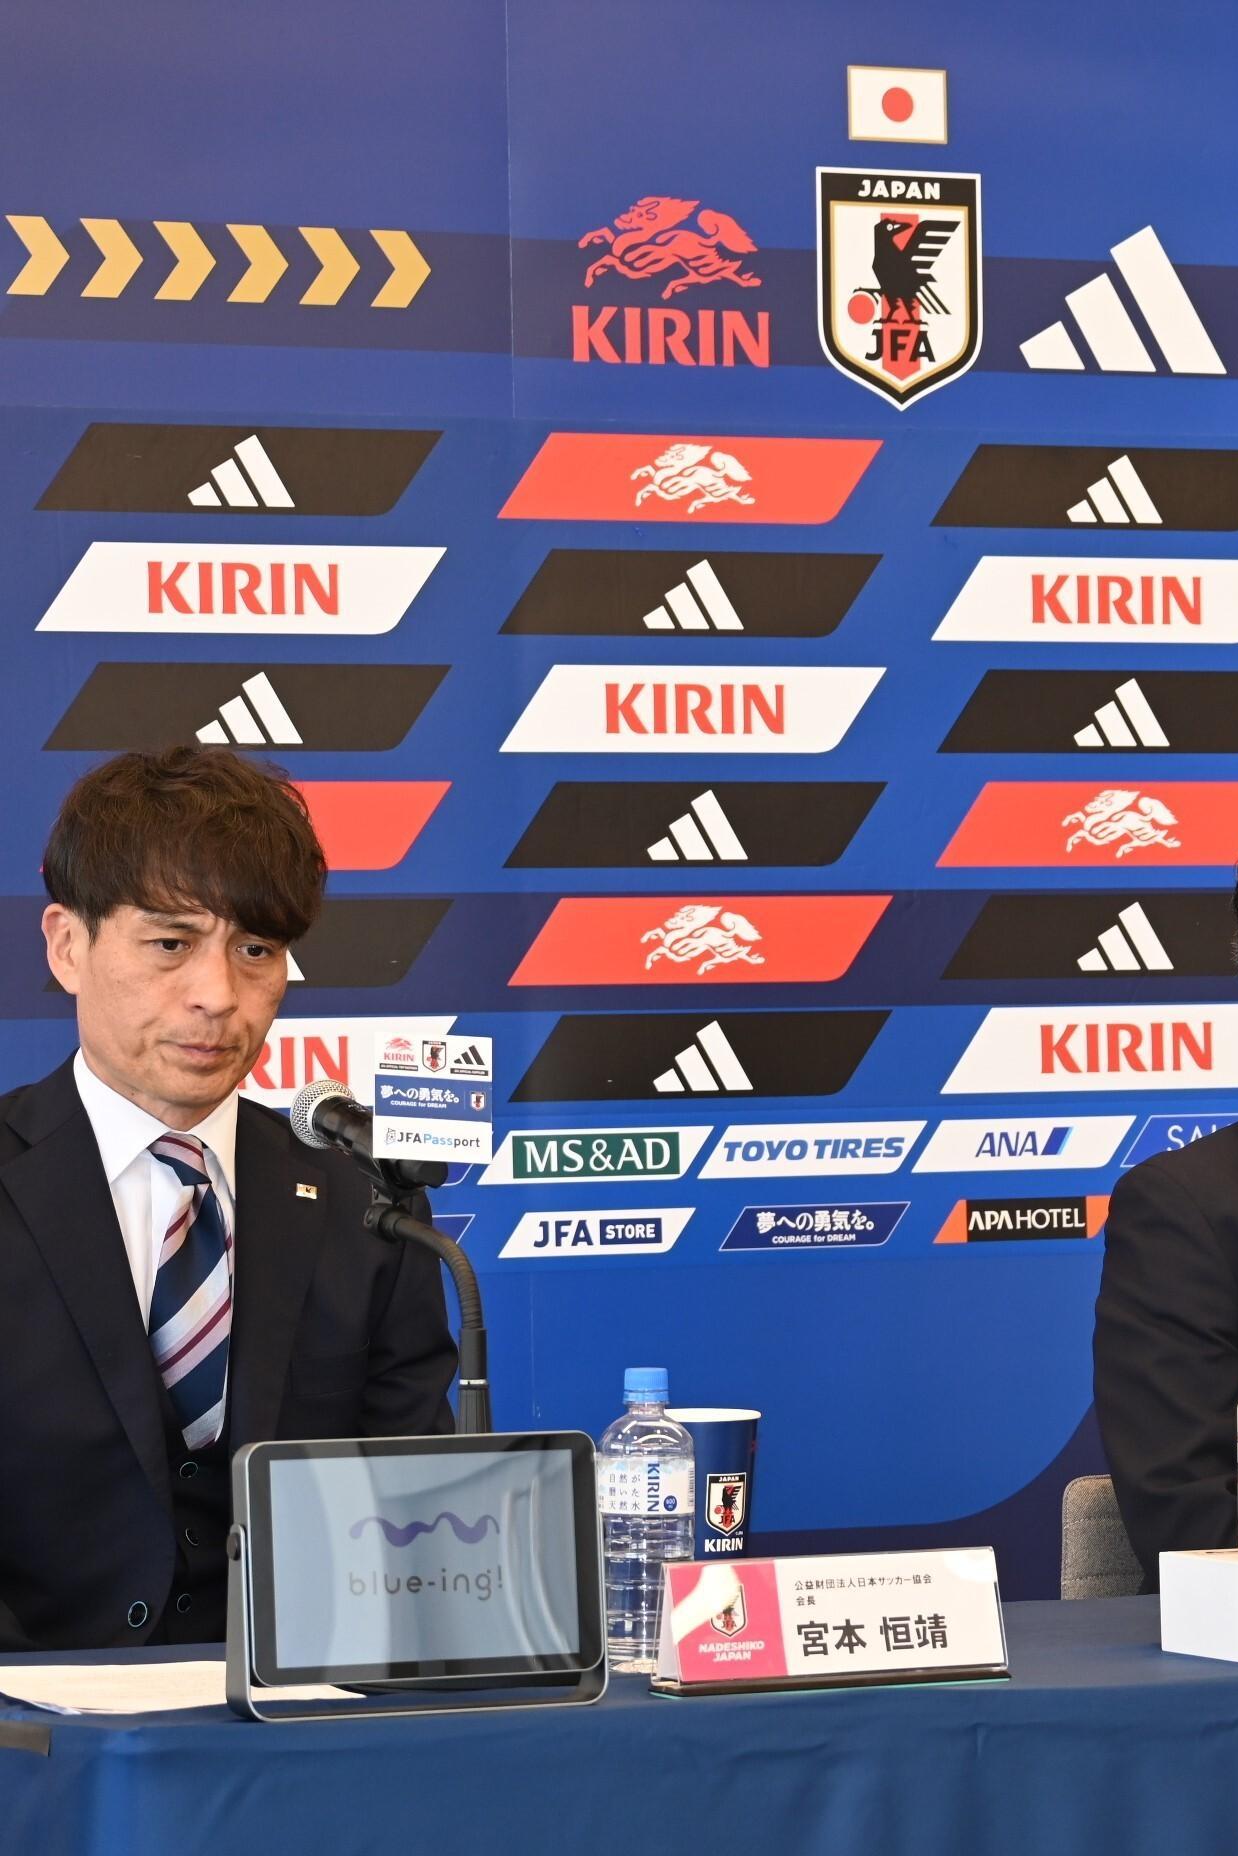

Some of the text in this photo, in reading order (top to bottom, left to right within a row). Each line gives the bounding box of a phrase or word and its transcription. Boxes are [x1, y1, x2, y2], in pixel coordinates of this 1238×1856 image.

[858, 179, 941, 200] JAPAN
[571, 305, 770, 368] KIRIN
[865, 329, 935, 363] JFA
[146, 561, 339, 616] KIRIN
[1030, 574, 1203, 625] KIRIN
[604, 683, 785, 735] KIRIN
[383, 1053, 415, 1061] KIRIN
[1039, 1021, 1213, 1074] KIRIN
[238, 1036, 348, 1089] RIN
[380, 1085, 460, 1103] 夢への勇気を。
[524, 1138, 671, 1173] MS&AD
[723, 1136, 905, 1162] TOYO TIRES
[975, 1131, 1038, 1157] ANA
[756, 1209, 874, 1235] 夢への勇気を。
[968, 1207, 1086, 1231] APA HOTEL
[533, 1219, 656, 1248] JFA STORE
[772, 1233, 856, 1244] COURAGE for DREAM
[647, 1463, 660, 1512] KIRIN
[719, 1515, 736, 1525] JFA
[704, 1537, 743, 1552] KIRIN
[349, 1565, 503, 1601] blue-ing!
[795, 1573, 932, 1591] 公益財団法人日本サッカー協会
[796, 1595, 816, 1607] 会長
[699, 1640, 765, 1653] NADESHIKO
[797, 1613, 948, 1657] 宮本 恒靖
[713, 1650, 752, 1662] JAPAN
